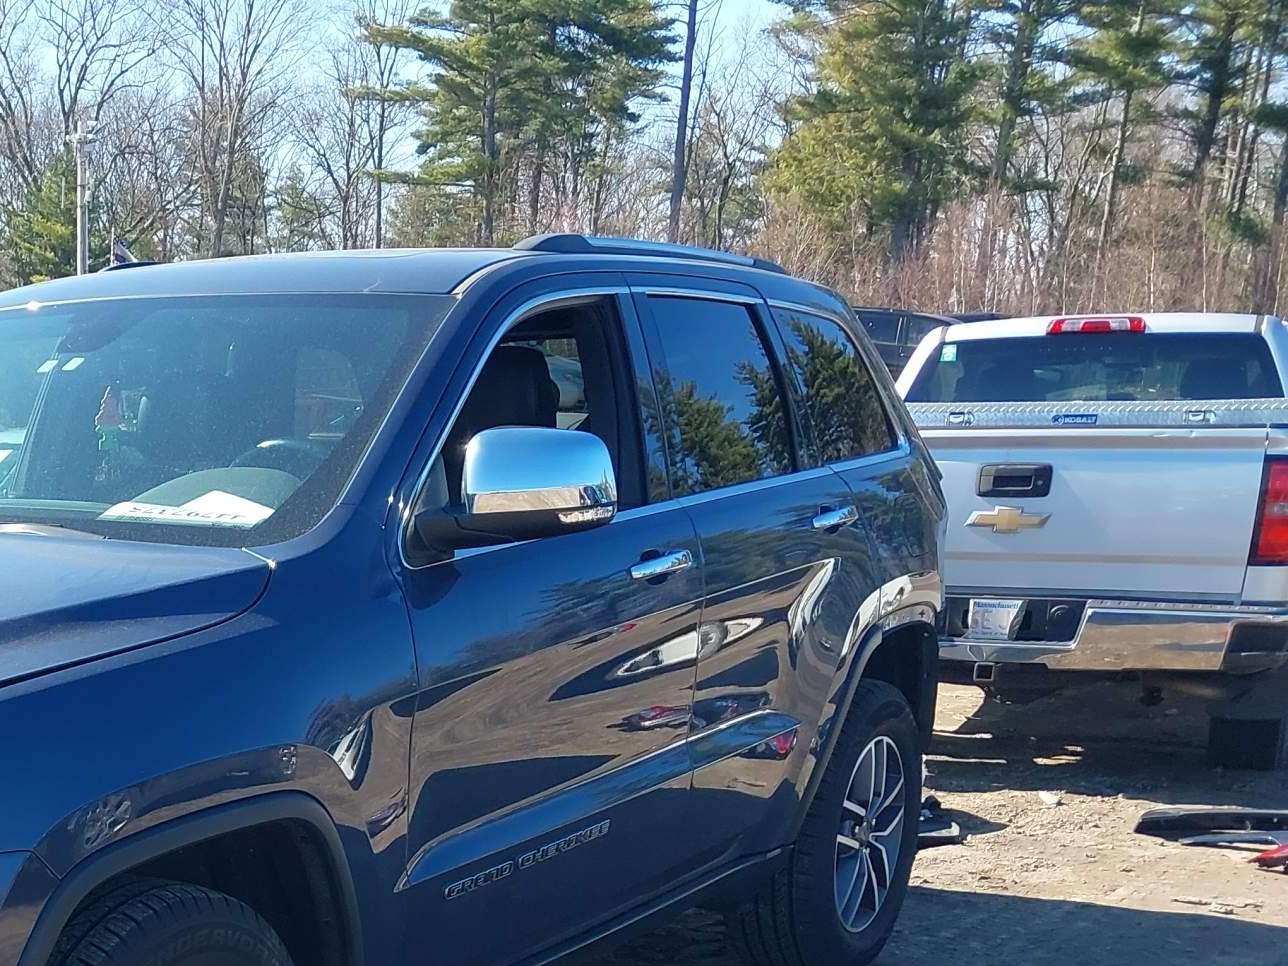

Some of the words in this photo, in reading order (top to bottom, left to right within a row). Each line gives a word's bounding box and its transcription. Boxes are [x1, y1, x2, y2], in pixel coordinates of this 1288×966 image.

[1064, 416, 1097, 424] KOBALT
[443, 861, 514, 900] GRAND
[517, 819, 612, 870] CHEROKEE
